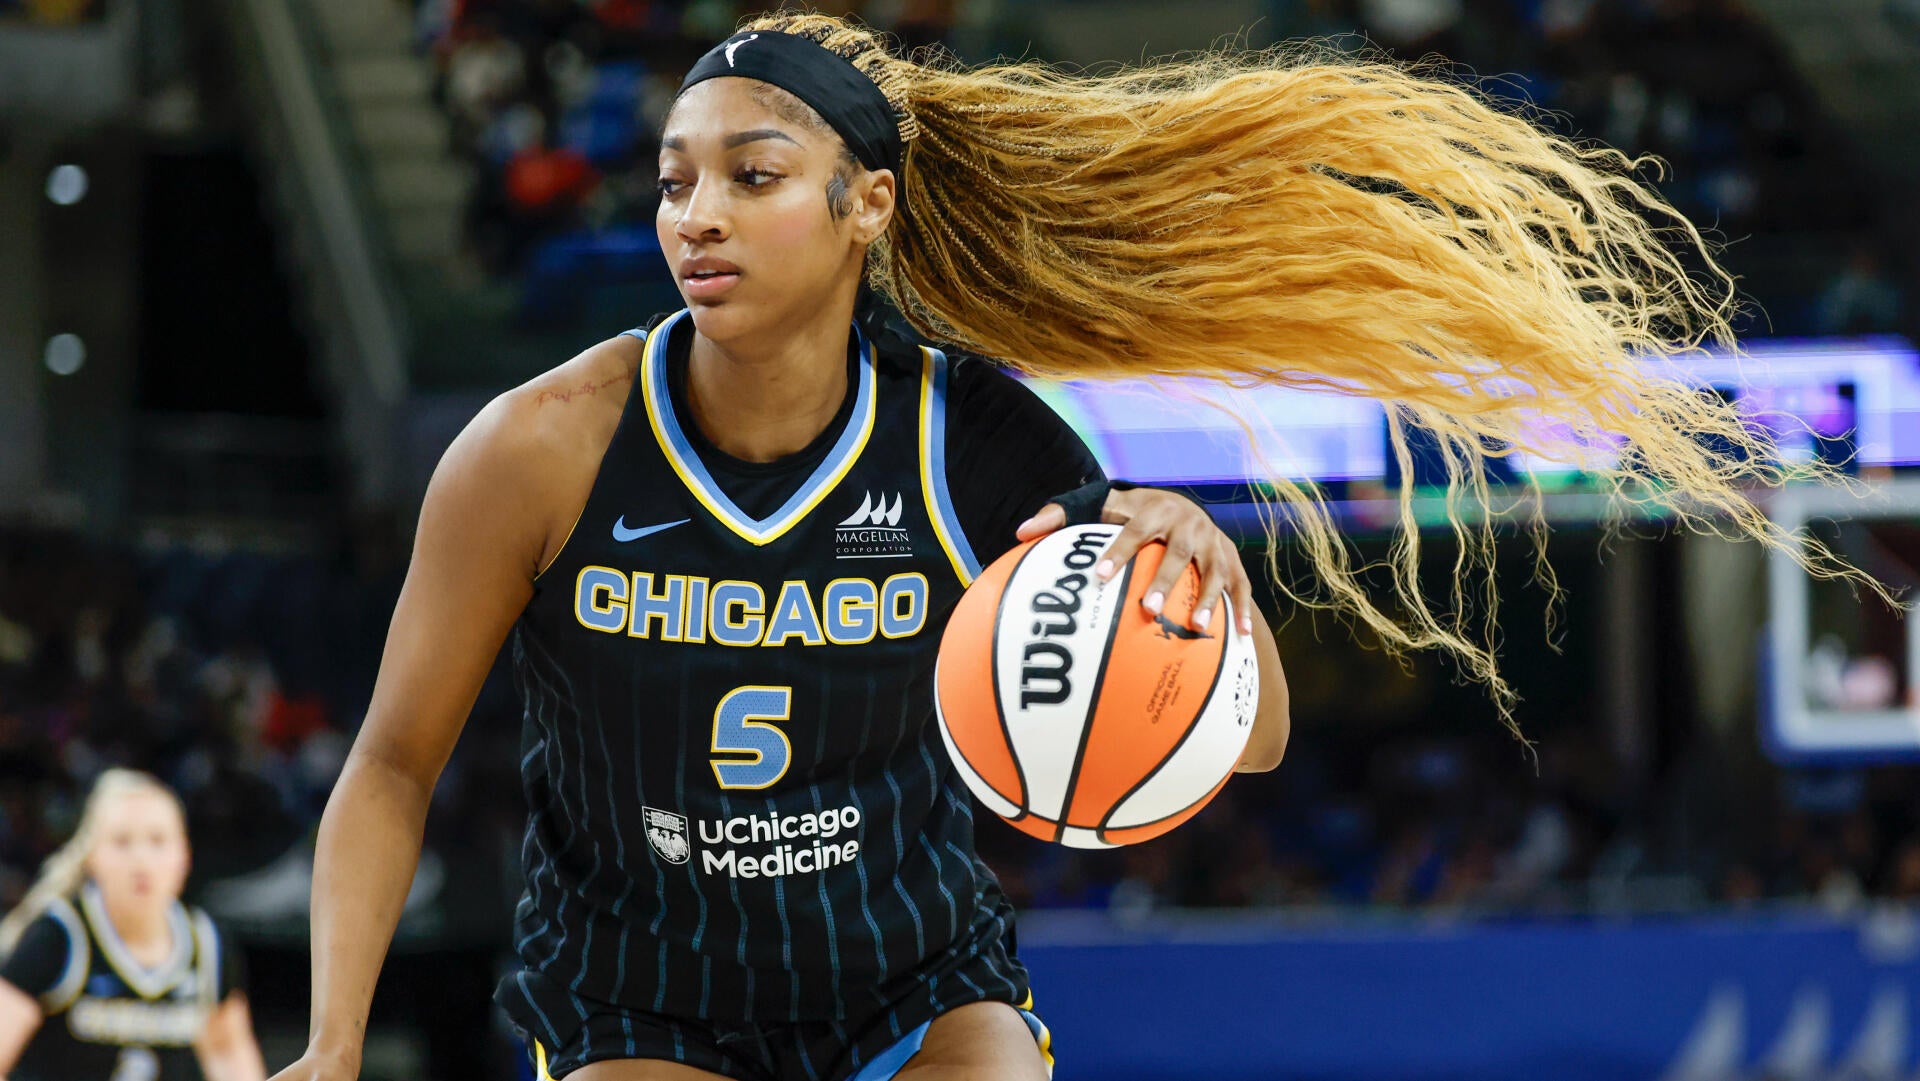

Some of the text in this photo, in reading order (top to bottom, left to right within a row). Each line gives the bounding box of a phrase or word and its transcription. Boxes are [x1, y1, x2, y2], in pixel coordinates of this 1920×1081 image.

[835, 531, 910, 543] MAGELLAN
[836, 545, 912, 554] CORPORATION
[574, 565, 929, 647] CHICAGO
[1019, 531, 1113, 712] Wilson
[1146, 662, 1173, 713] OFFICIAL
[1151, 690, 1171, 725] GAME
[1167, 658, 1186, 689] BALL
[709, 684, 792, 790] 5
[698, 805, 861, 844] UChicago
[701, 839, 860, 879] Medicine
